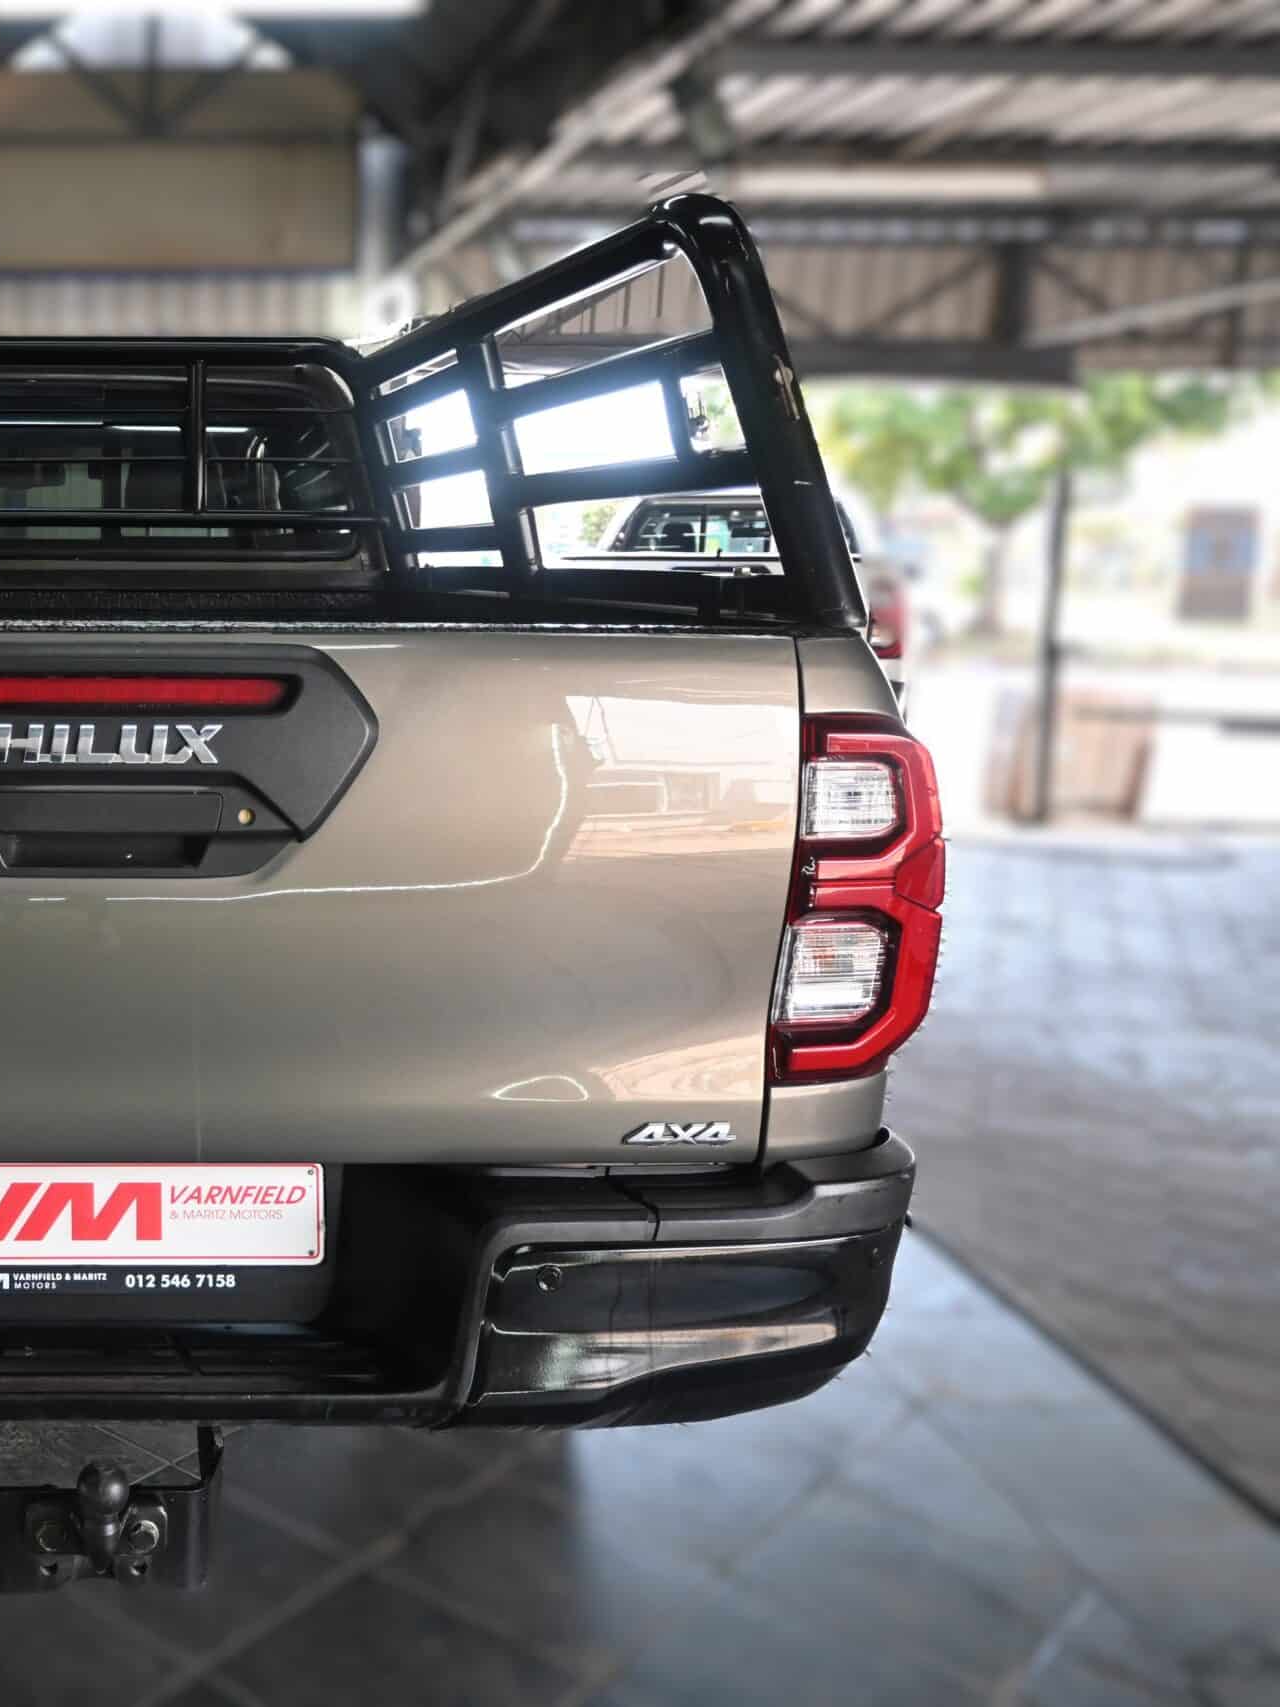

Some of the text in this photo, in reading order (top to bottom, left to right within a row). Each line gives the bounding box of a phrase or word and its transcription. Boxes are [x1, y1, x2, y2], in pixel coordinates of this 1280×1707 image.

[169, 1184, 308, 1206] VARNFIELD
[182, 1208, 227, 1221] MARITZ
[229, 1208, 284, 1221] MOTORS
[12, 1272, 63, 1281] VARNFIELD
[73, 1272, 108, 1281] MARITZ
[124, 1273, 237, 1289] 012 546 7158
[13, 1281, 57, 1290] MOTORS
